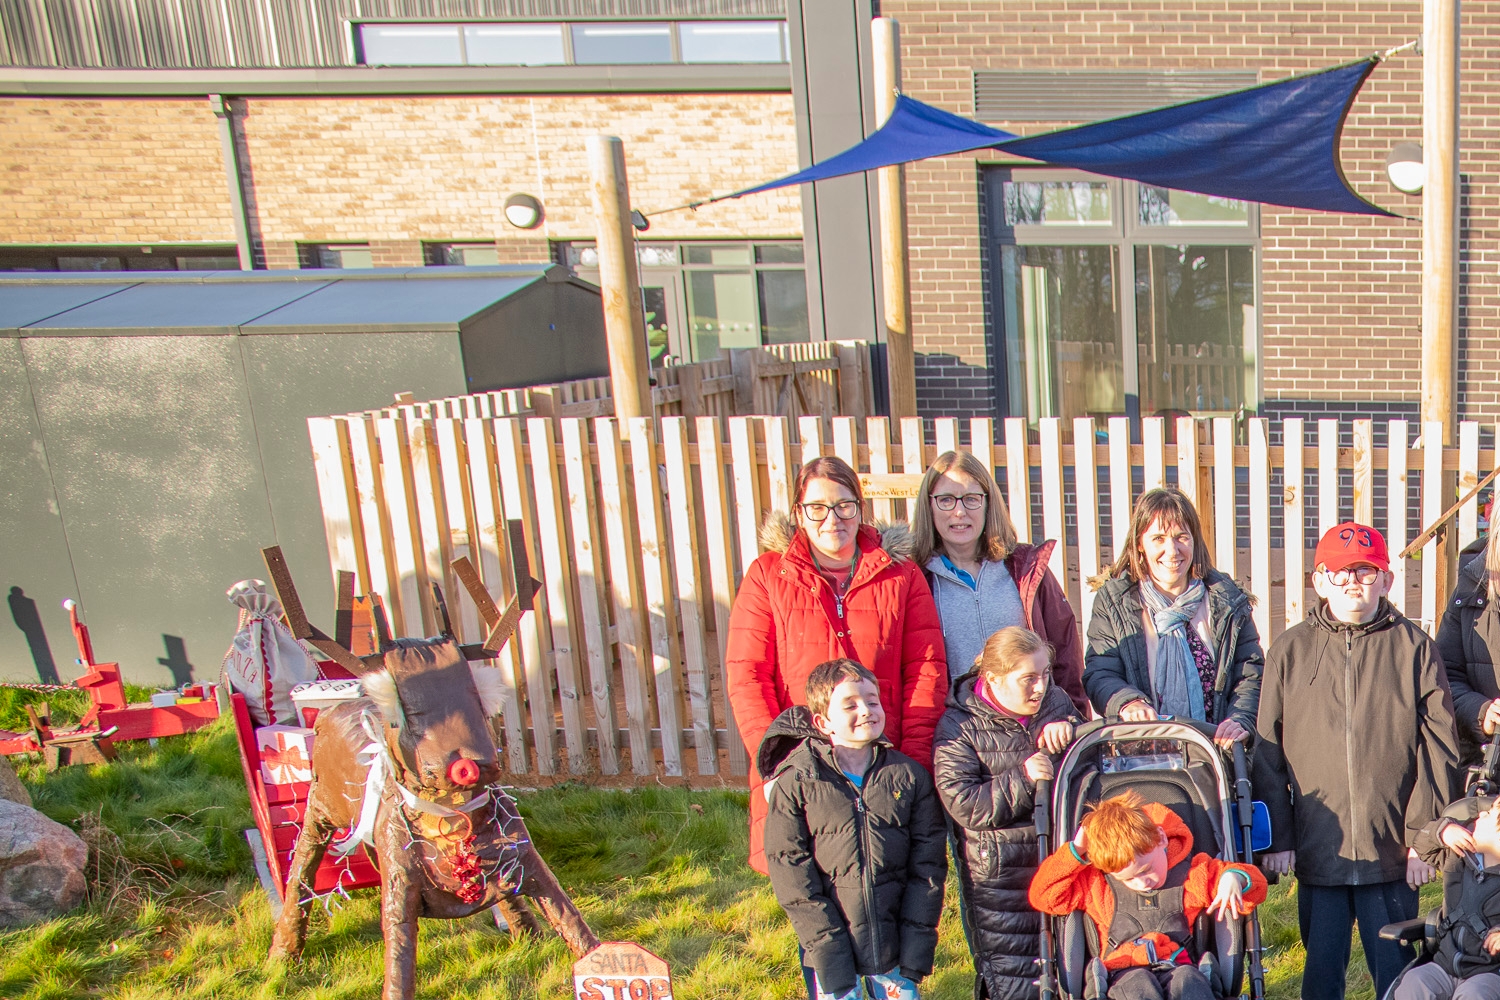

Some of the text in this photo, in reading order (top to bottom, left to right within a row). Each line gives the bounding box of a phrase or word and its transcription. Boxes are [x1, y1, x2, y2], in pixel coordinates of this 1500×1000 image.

[889, 487, 909, 497] WEST
[1339, 527, 1373, 549] 93
[590, 952, 649, 974] SANTA
